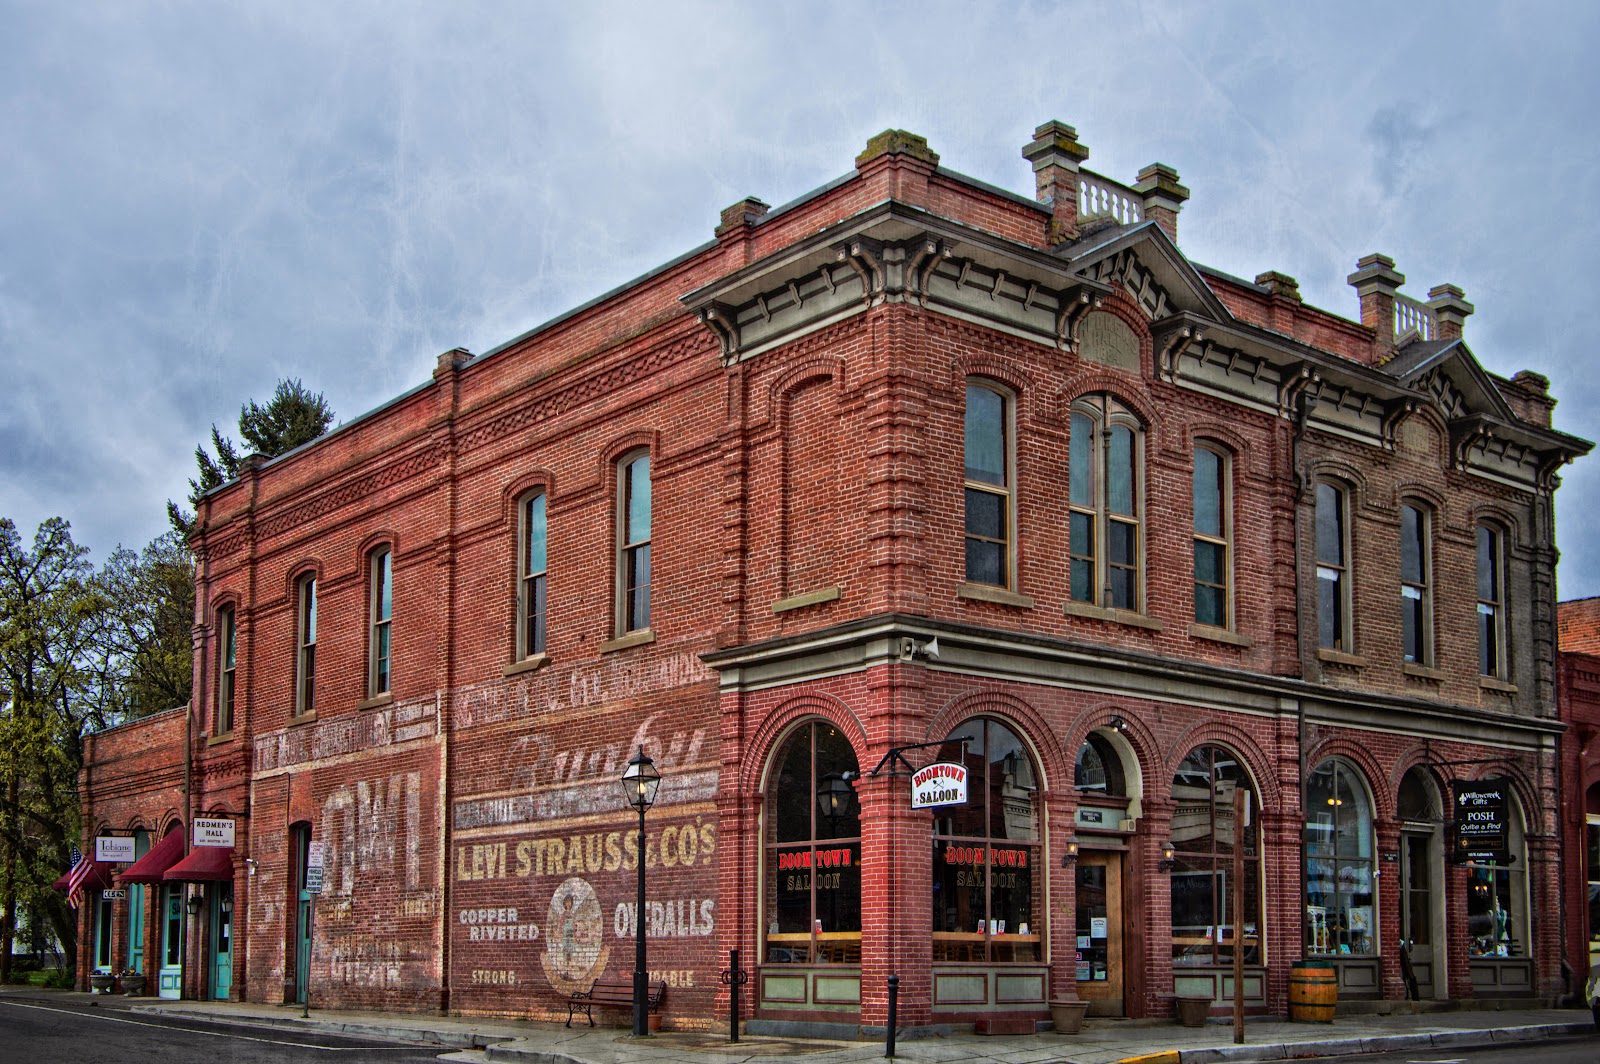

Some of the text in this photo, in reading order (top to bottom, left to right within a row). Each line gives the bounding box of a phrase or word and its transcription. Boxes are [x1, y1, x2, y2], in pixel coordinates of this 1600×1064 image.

[914, 765, 965, 788] BOOMTOWN
[919, 788, 959, 804] SALOON
[1467, 811, 1495, 821] POSH
[196, 821, 233, 829] REDMEN'S
[1460, 823, 1480, 832] Quite
[205, 829, 224, 837] HALL
[100, 839, 132, 851] Tobiano
[457, 842, 507, 881] LEVI
[515, 829, 641, 878] STRAUSS
[459, 907, 519, 925] COPPER
[469, 923, 540, 942] RIVETED
